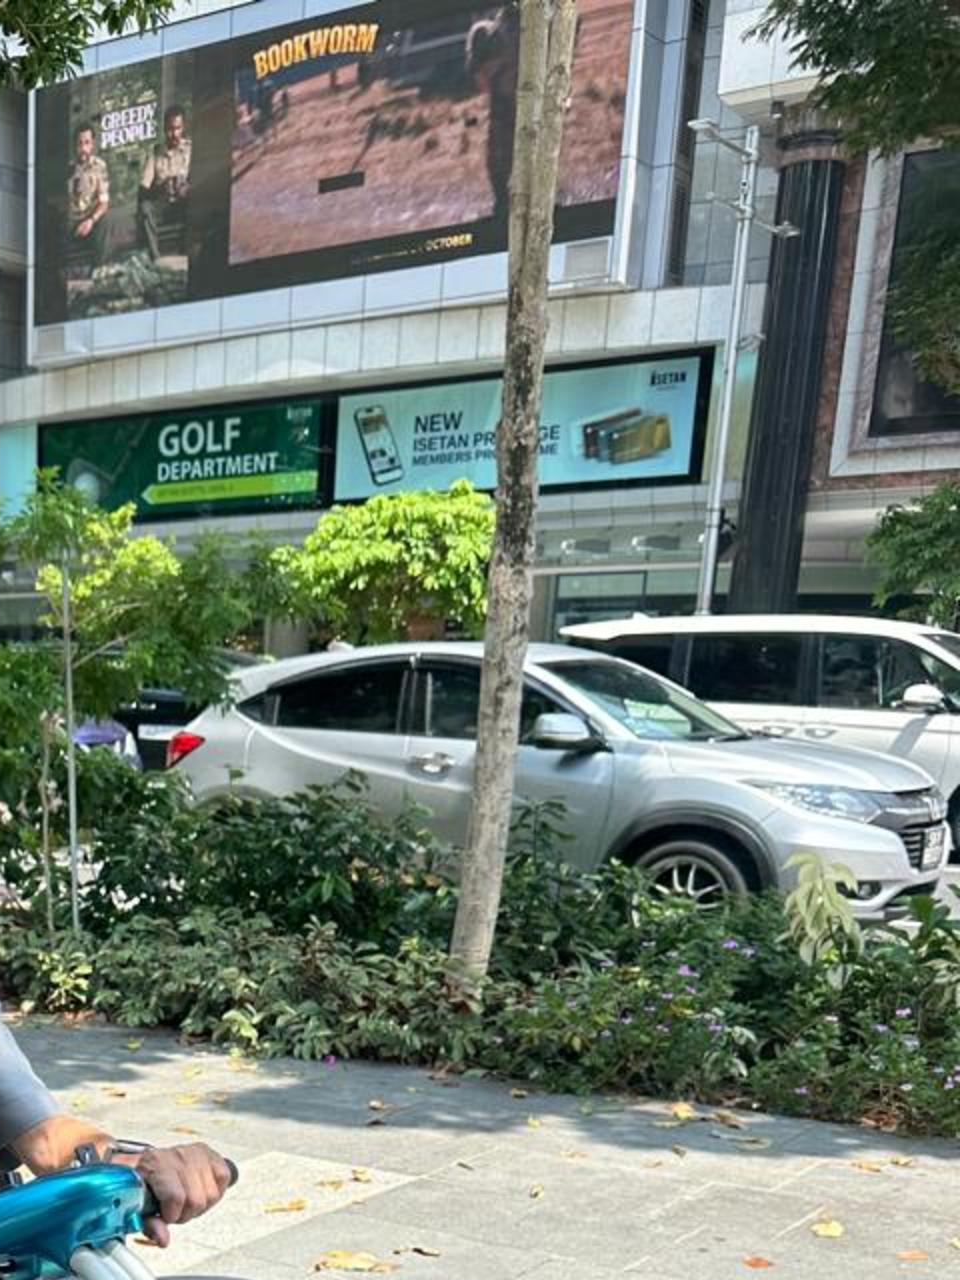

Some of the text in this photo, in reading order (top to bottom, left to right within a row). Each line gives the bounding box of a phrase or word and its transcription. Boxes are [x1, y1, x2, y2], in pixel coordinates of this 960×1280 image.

[253, 23, 380, 80] BOOKWORM
[101, 102, 157, 130] GREEDY
[101, 121, 157, 149] PEOPLE
[426, 233, 473, 251] OCTOBER
[414, 411, 462, 433] NEW
[158, 417, 241, 456] GOLF
[413, 432, 469, 452] ISETAN
[157, 452, 279, 482] DEPARTMENT
[412, 451, 472, 466] MEMBERS
